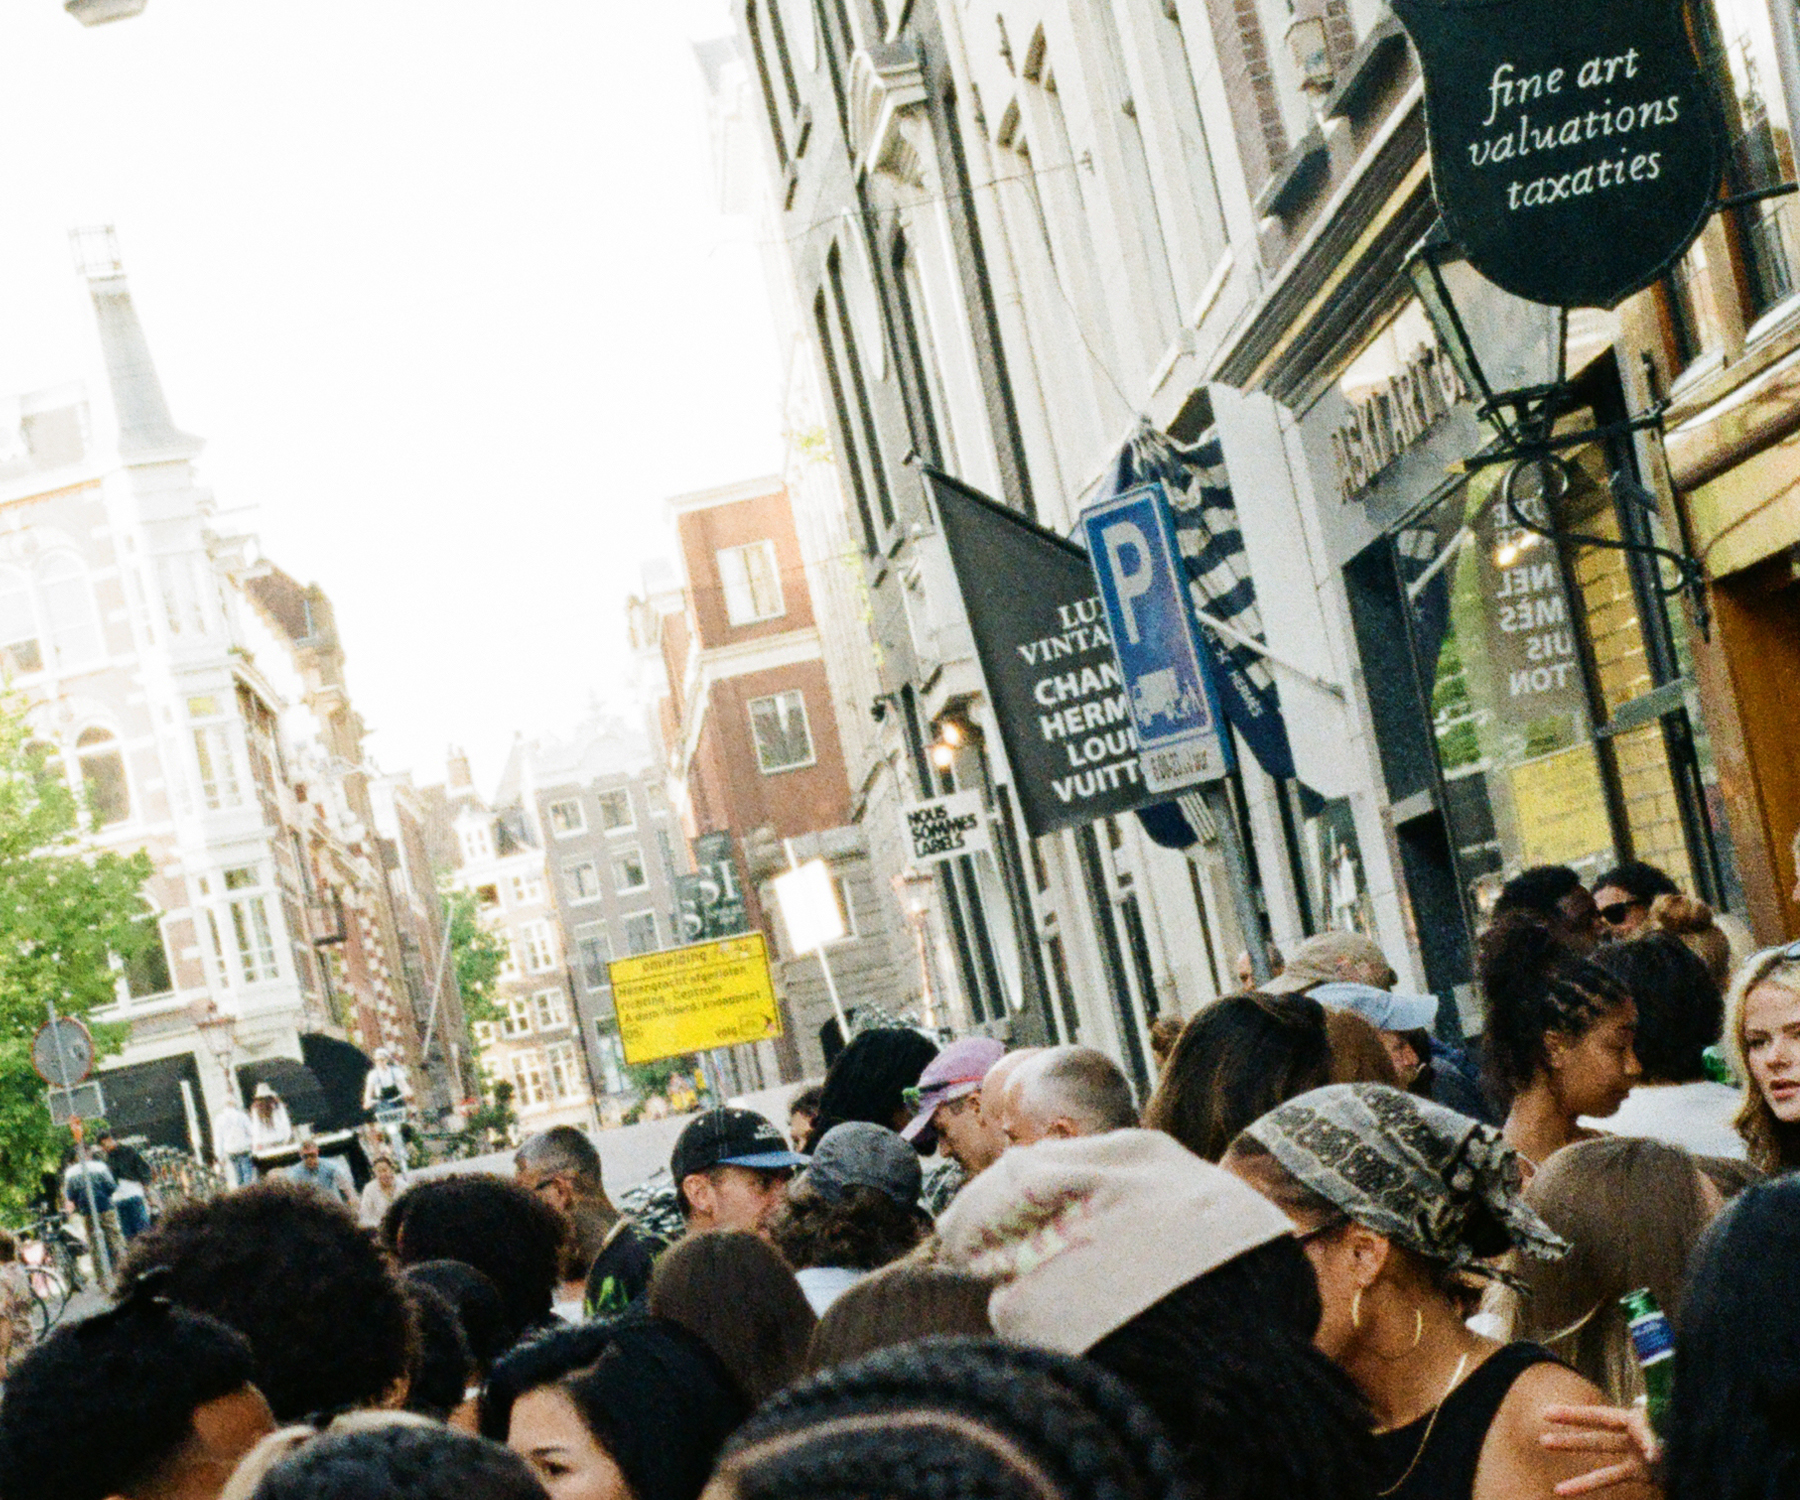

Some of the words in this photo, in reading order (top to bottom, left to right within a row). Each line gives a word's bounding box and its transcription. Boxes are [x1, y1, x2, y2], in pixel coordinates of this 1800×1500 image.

[1482, 62, 1565, 127] fine
[1576, 47, 1640, 89] art
[1467, 95, 1680, 167] valuations
[1505, 146, 1662, 211] taxaties
[1102, 520, 1152, 646] P
[1057, 596, 1104, 630] LU
[1017, 624, 1111, 666] VINTA
[1034, 660, 1122, 706] CHAN
[1039, 694, 1129, 741] HERM
[1066, 727, 1139, 767] LOUI
[1051, 758, 1139, 803] VUITT
[906, 804, 948, 826] NOUS
[911, 813, 978, 843] SOMMES
[913, 833, 966, 859] LABELS
